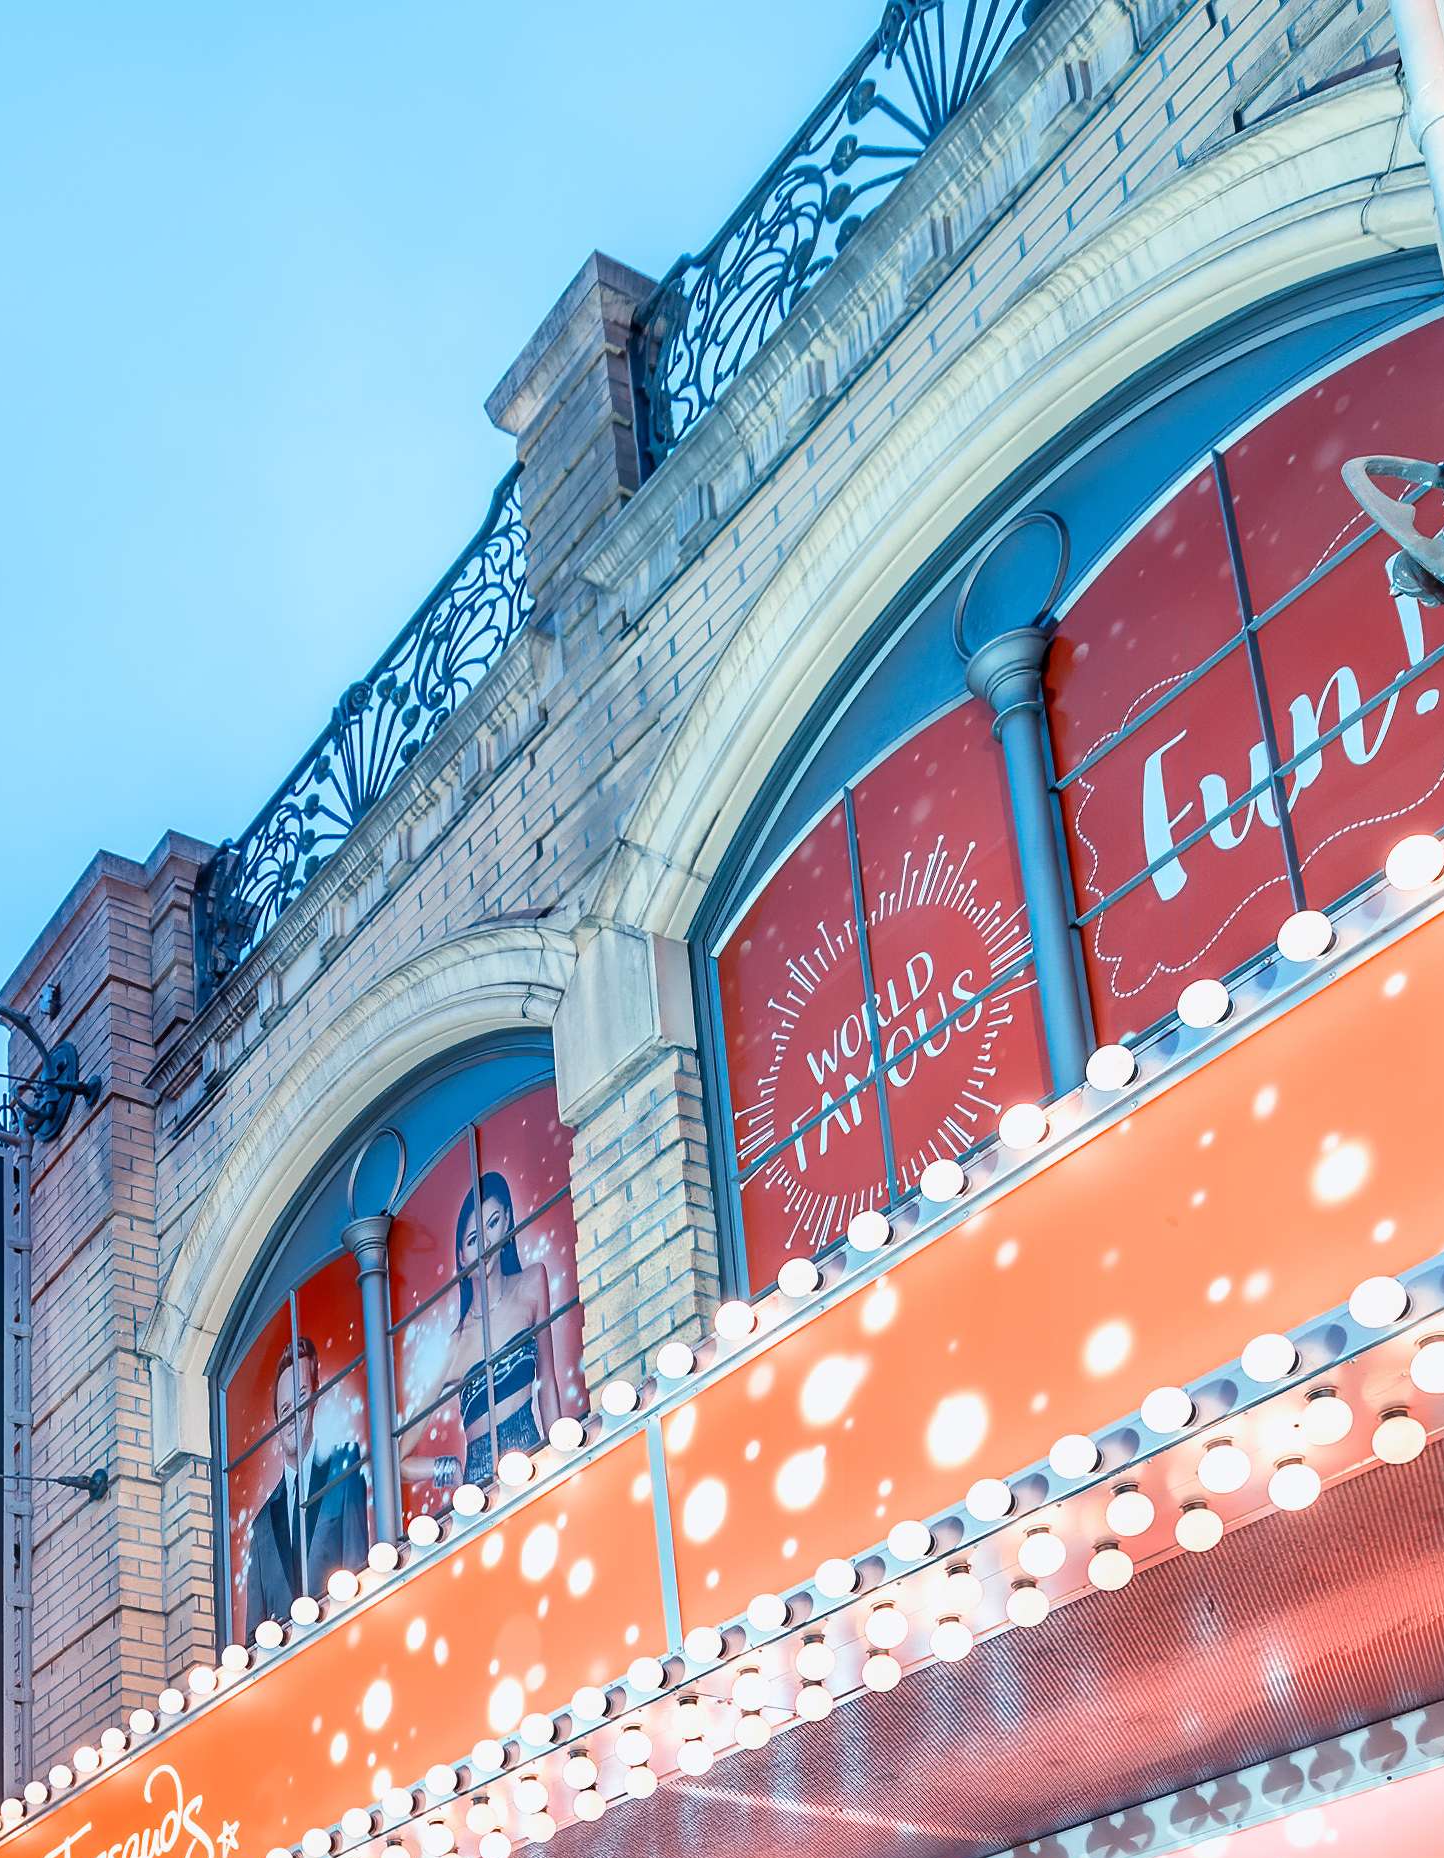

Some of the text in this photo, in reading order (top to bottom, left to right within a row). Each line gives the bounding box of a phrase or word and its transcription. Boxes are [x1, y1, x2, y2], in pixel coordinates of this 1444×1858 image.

[1141, 590, 1442, 901] Fun!
[791, 969, 982, 1172] FAMOUS
[806, 950, 936, 1085] WORLD
